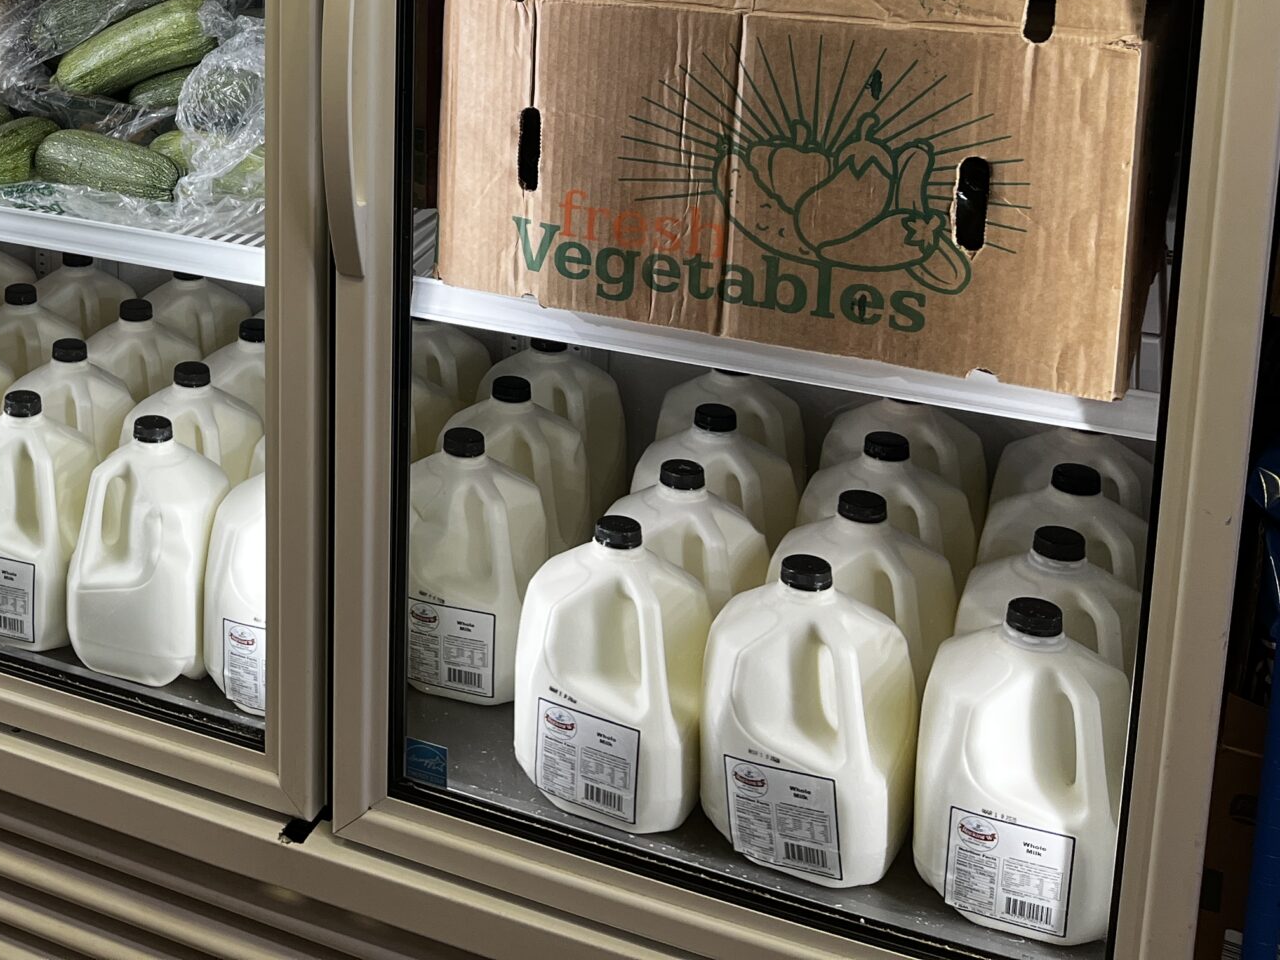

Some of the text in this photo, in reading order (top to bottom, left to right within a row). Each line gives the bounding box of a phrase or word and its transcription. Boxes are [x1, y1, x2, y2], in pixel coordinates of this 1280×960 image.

[558, 188, 726, 259] fresh
[512, 215, 927, 333] Vegetables
[457, 620, 475, 628] Whole
[596, 732, 617, 743] Whole
[599, 738, 613, 747] Milk
[789, 785, 812, 795] Whole
[793, 792, 809, 800] Milk
[1022, 841, 1047, 852] Whole
[1025, 848, 1043, 857] Milk
